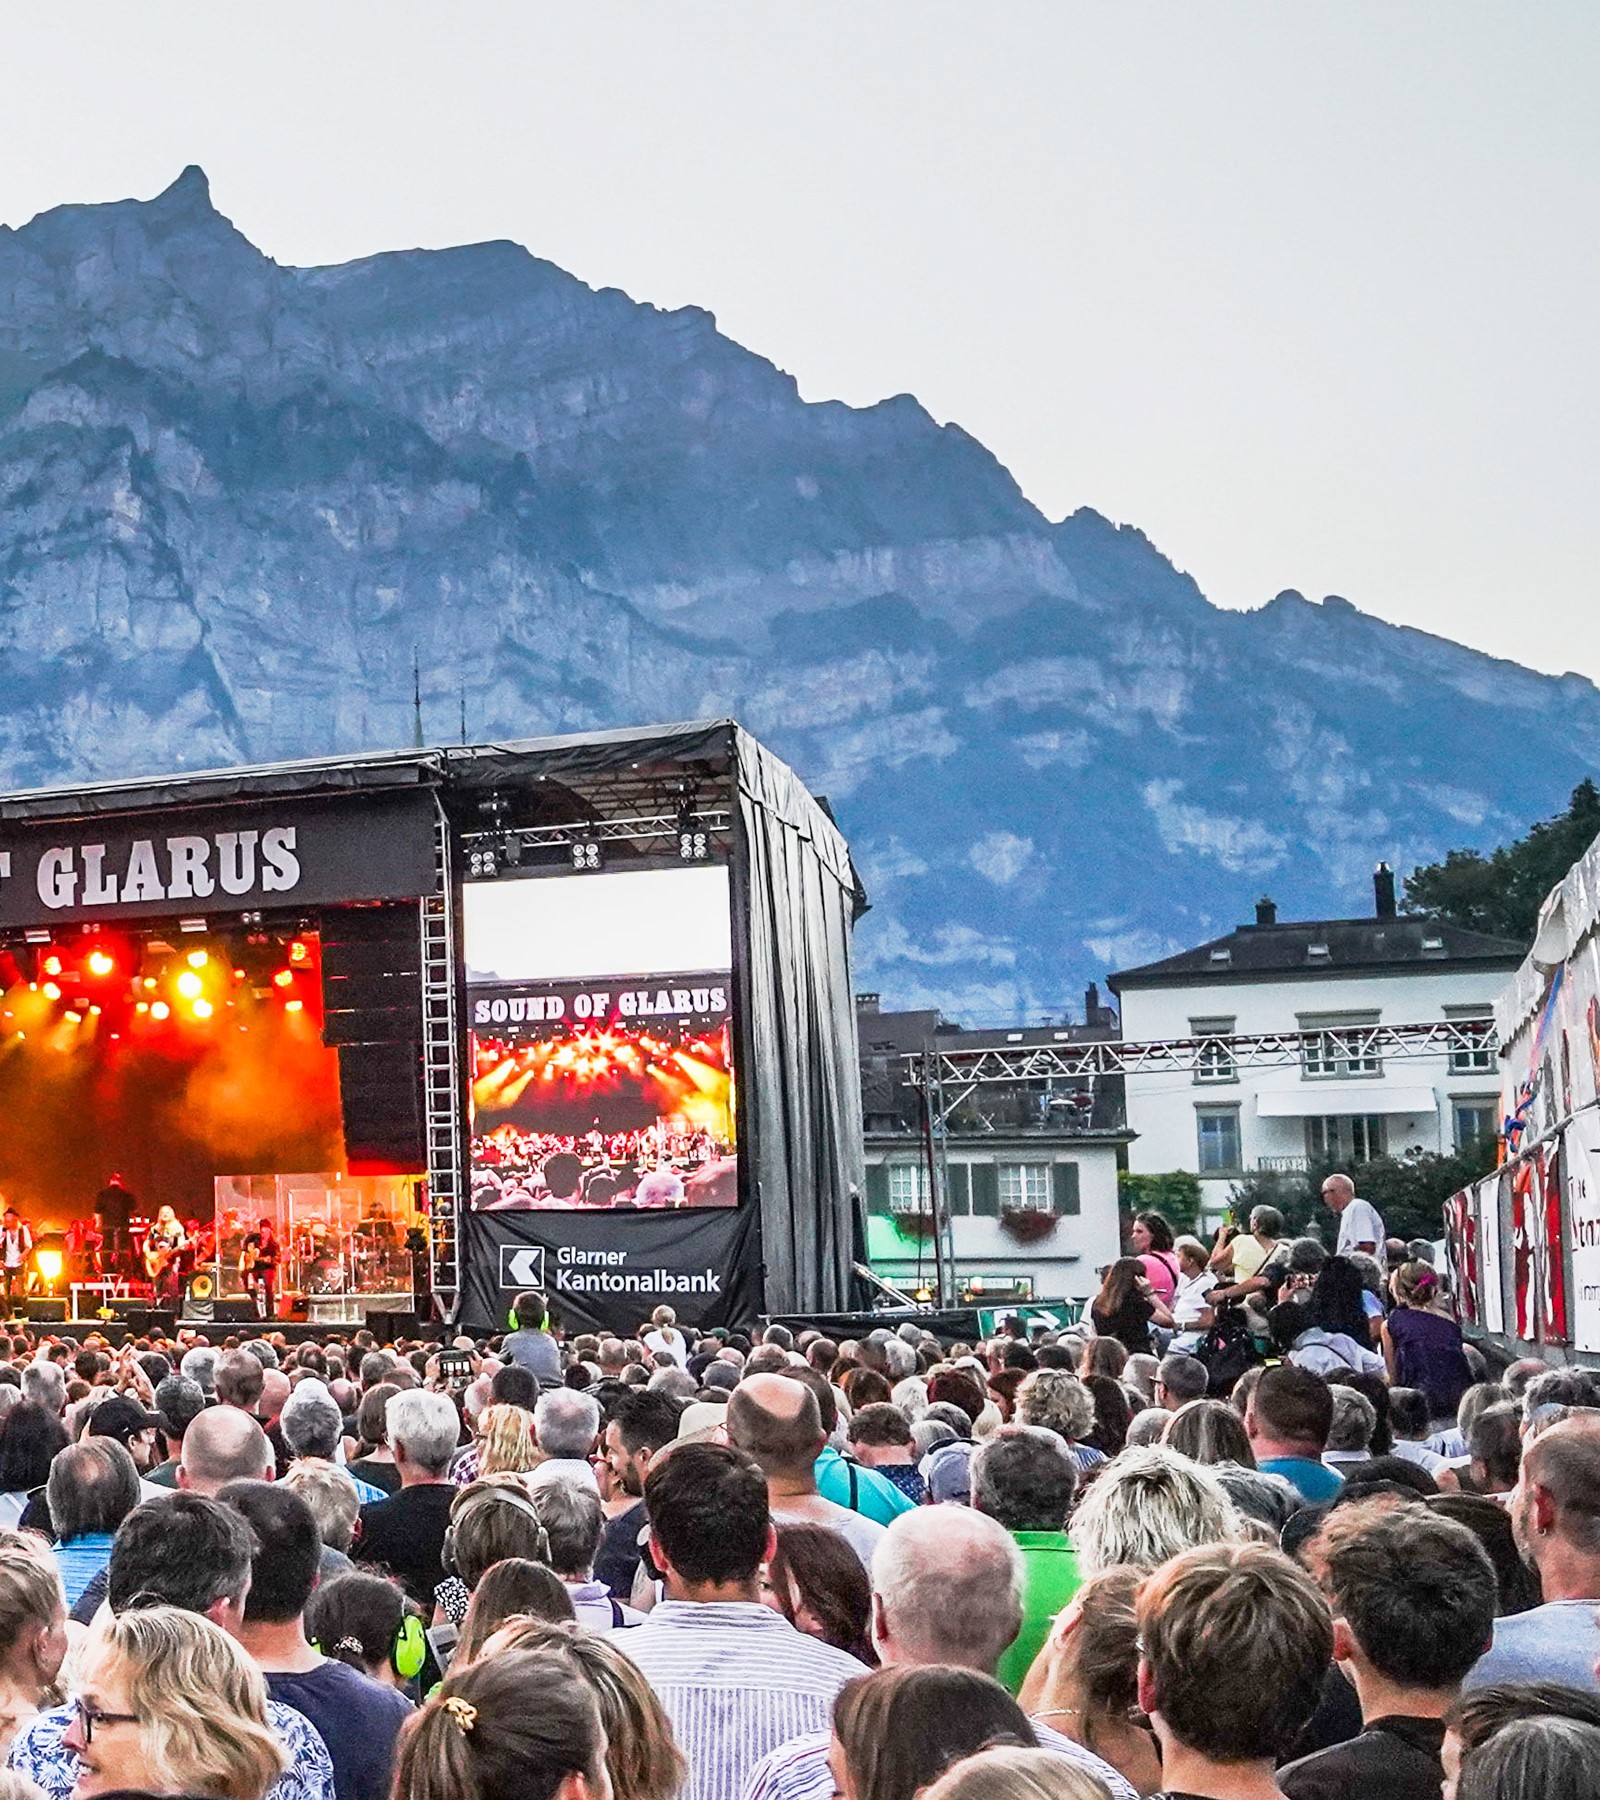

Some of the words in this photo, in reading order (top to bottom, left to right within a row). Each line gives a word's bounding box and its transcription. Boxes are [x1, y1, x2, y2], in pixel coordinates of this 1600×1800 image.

[37, 827, 301, 910] GLARUS
[475, 996, 565, 1024] SOUND
[573, 992, 610, 1018] OF
[618, 988, 728, 1017] GLARUS
[557, 1247, 627, 1266] Glarner
[556, 1267, 721, 1293] Kantonalbank
